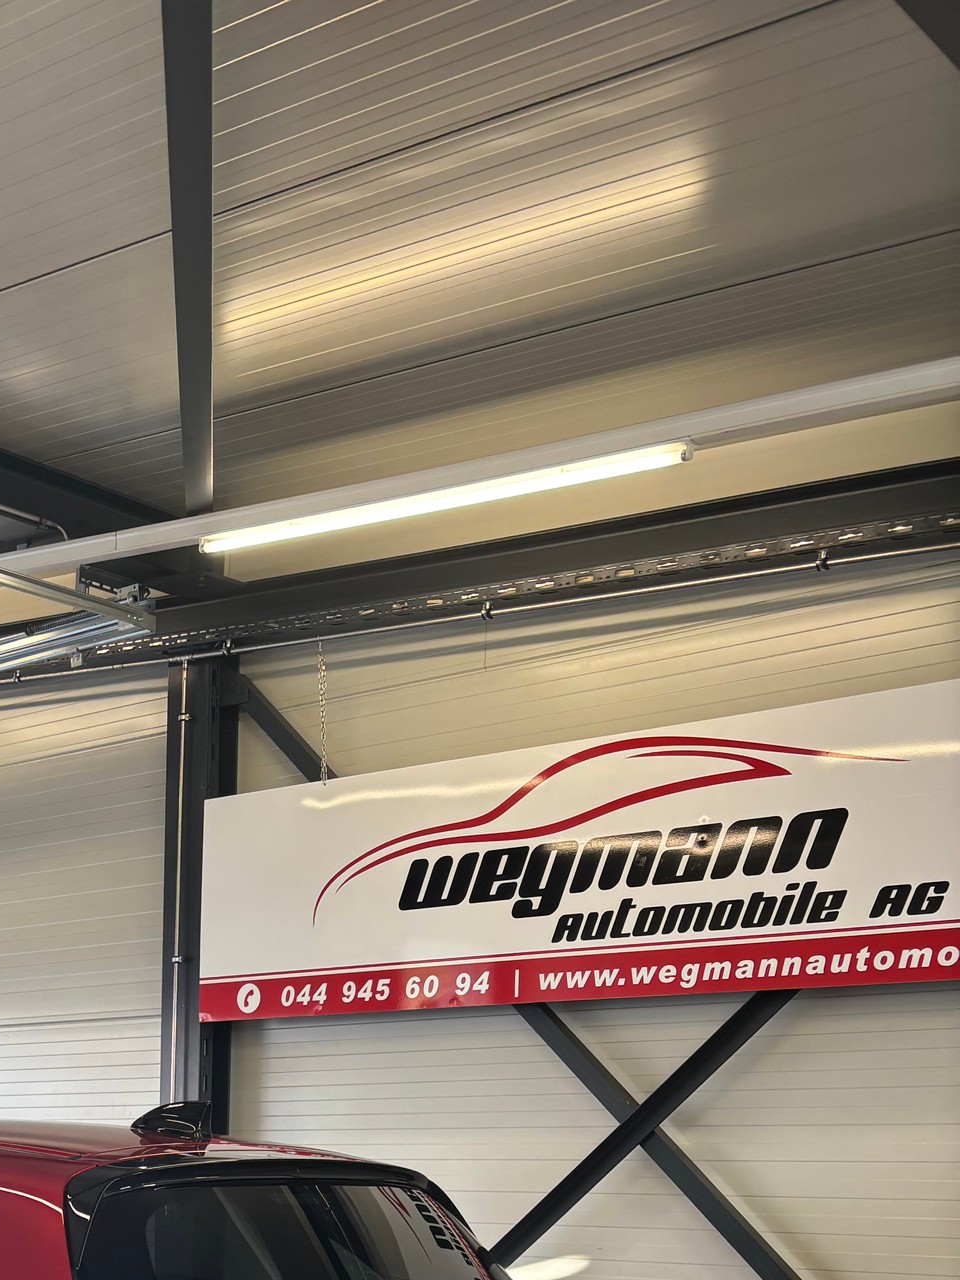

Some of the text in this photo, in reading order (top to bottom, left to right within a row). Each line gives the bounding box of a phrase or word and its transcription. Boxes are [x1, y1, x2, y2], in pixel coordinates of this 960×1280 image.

[398, 807, 849, 919] wegmann
[869, 881, 950, 919] AG
[280, 983, 328, 1008] 044
[341, 978, 391, 1004] 945
[405, 975, 440, 999] 60
[454, 970, 490, 997] 94
[538, 945, 960, 991] www.wegmannautomo
